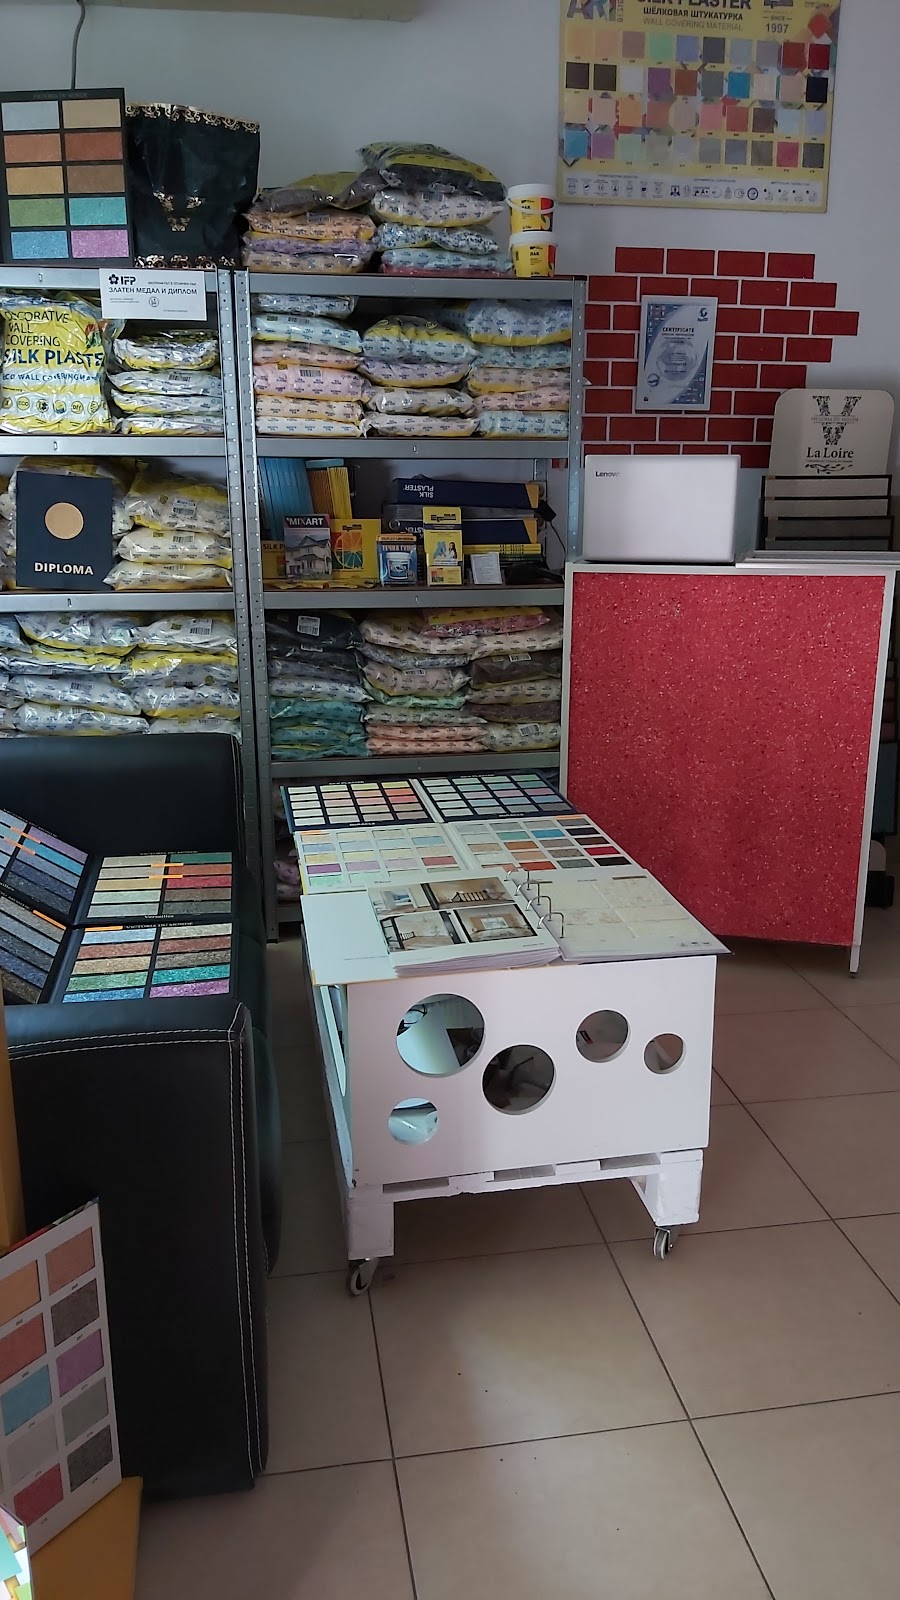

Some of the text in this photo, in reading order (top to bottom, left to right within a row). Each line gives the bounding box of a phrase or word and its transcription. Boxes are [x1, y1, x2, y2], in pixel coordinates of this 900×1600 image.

[643, 6, 744, 21] ШЁЛКОВАЯ ШТУКАТУРКА
[666, 19, 704, 28] COVERING
[707, 20, 742, 30] MATERIAL
[766, 23, 789, 34] 1997
[120, 276, 136, 285] IFP
[4, 349, 40, 364] SILK
[806, 447, 854, 458] La Loire
[288, 518, 323, 526] MIXART
[34, 562, 94, 575] DIPLOMA
